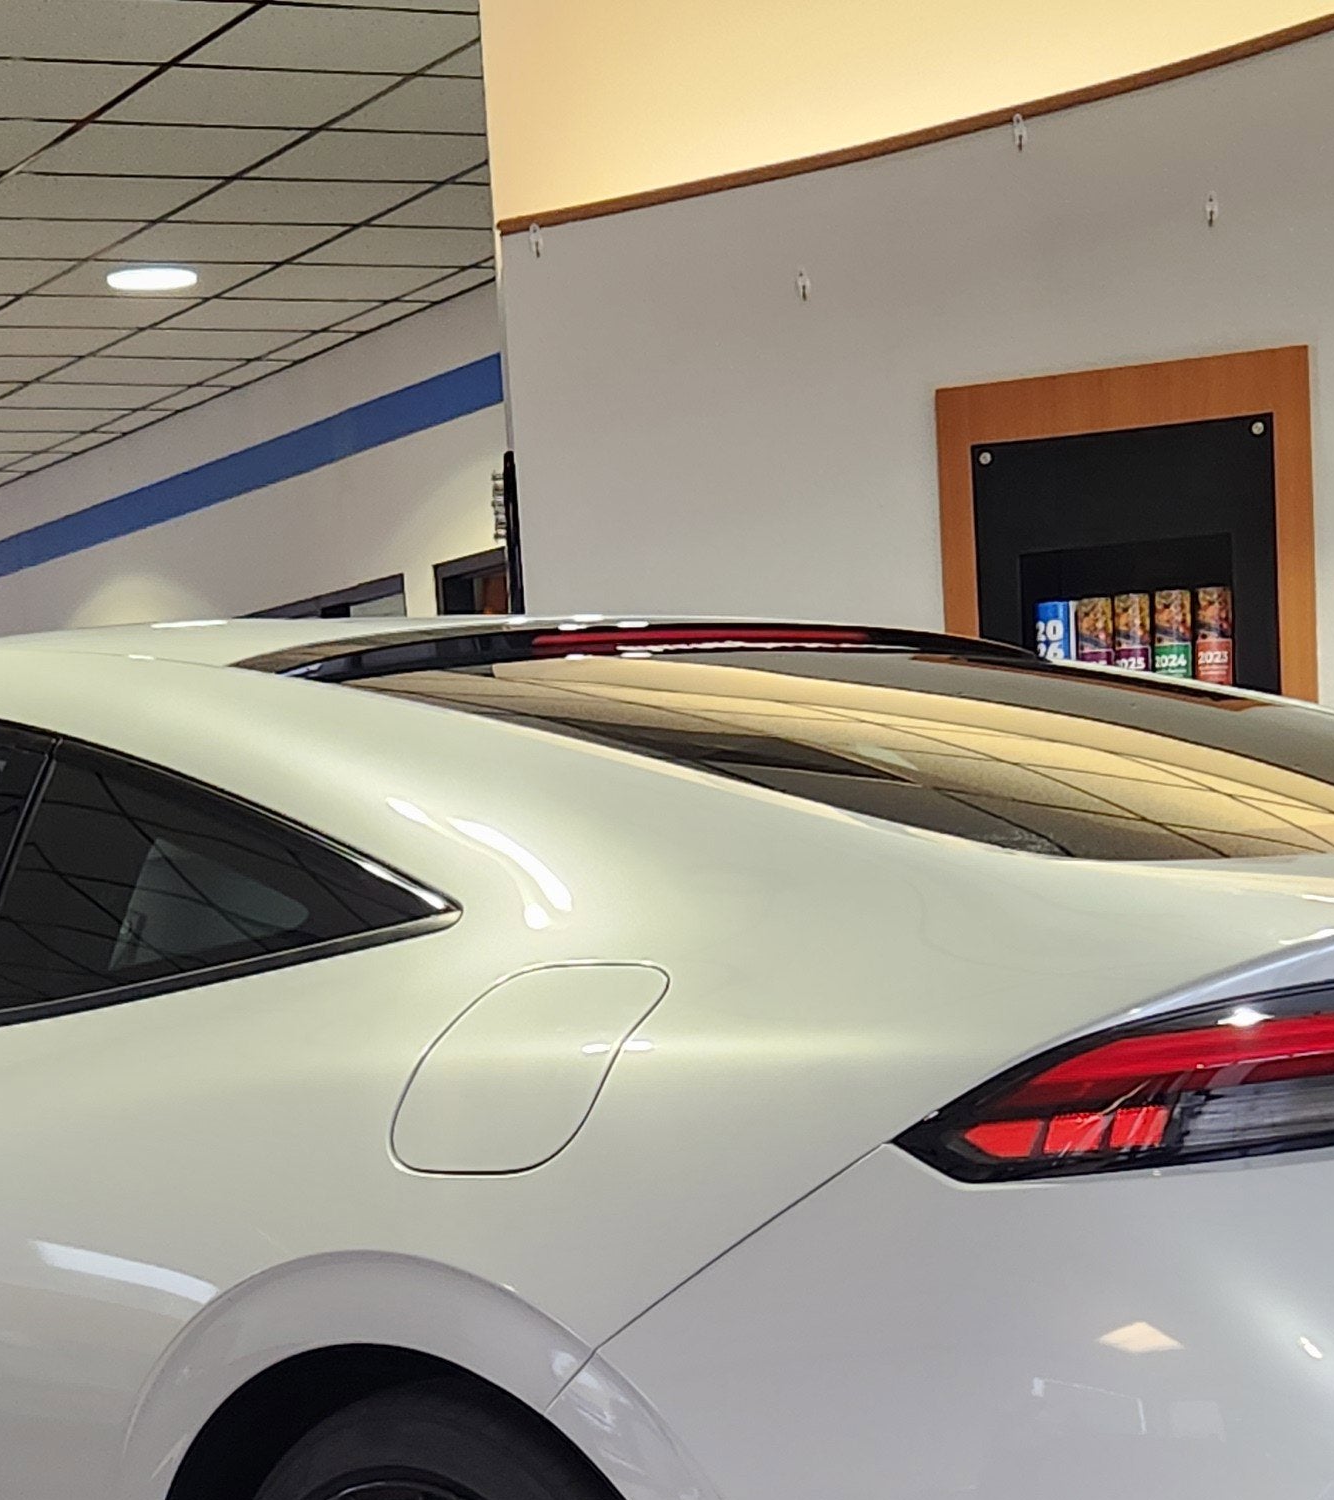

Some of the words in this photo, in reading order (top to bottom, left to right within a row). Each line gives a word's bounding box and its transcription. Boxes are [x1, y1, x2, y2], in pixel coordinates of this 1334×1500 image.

[1036, 620, 1064, 642] 20
[1155, 654, 1187, 668] 2024
[1198, 651, 1228, 664] 2023
